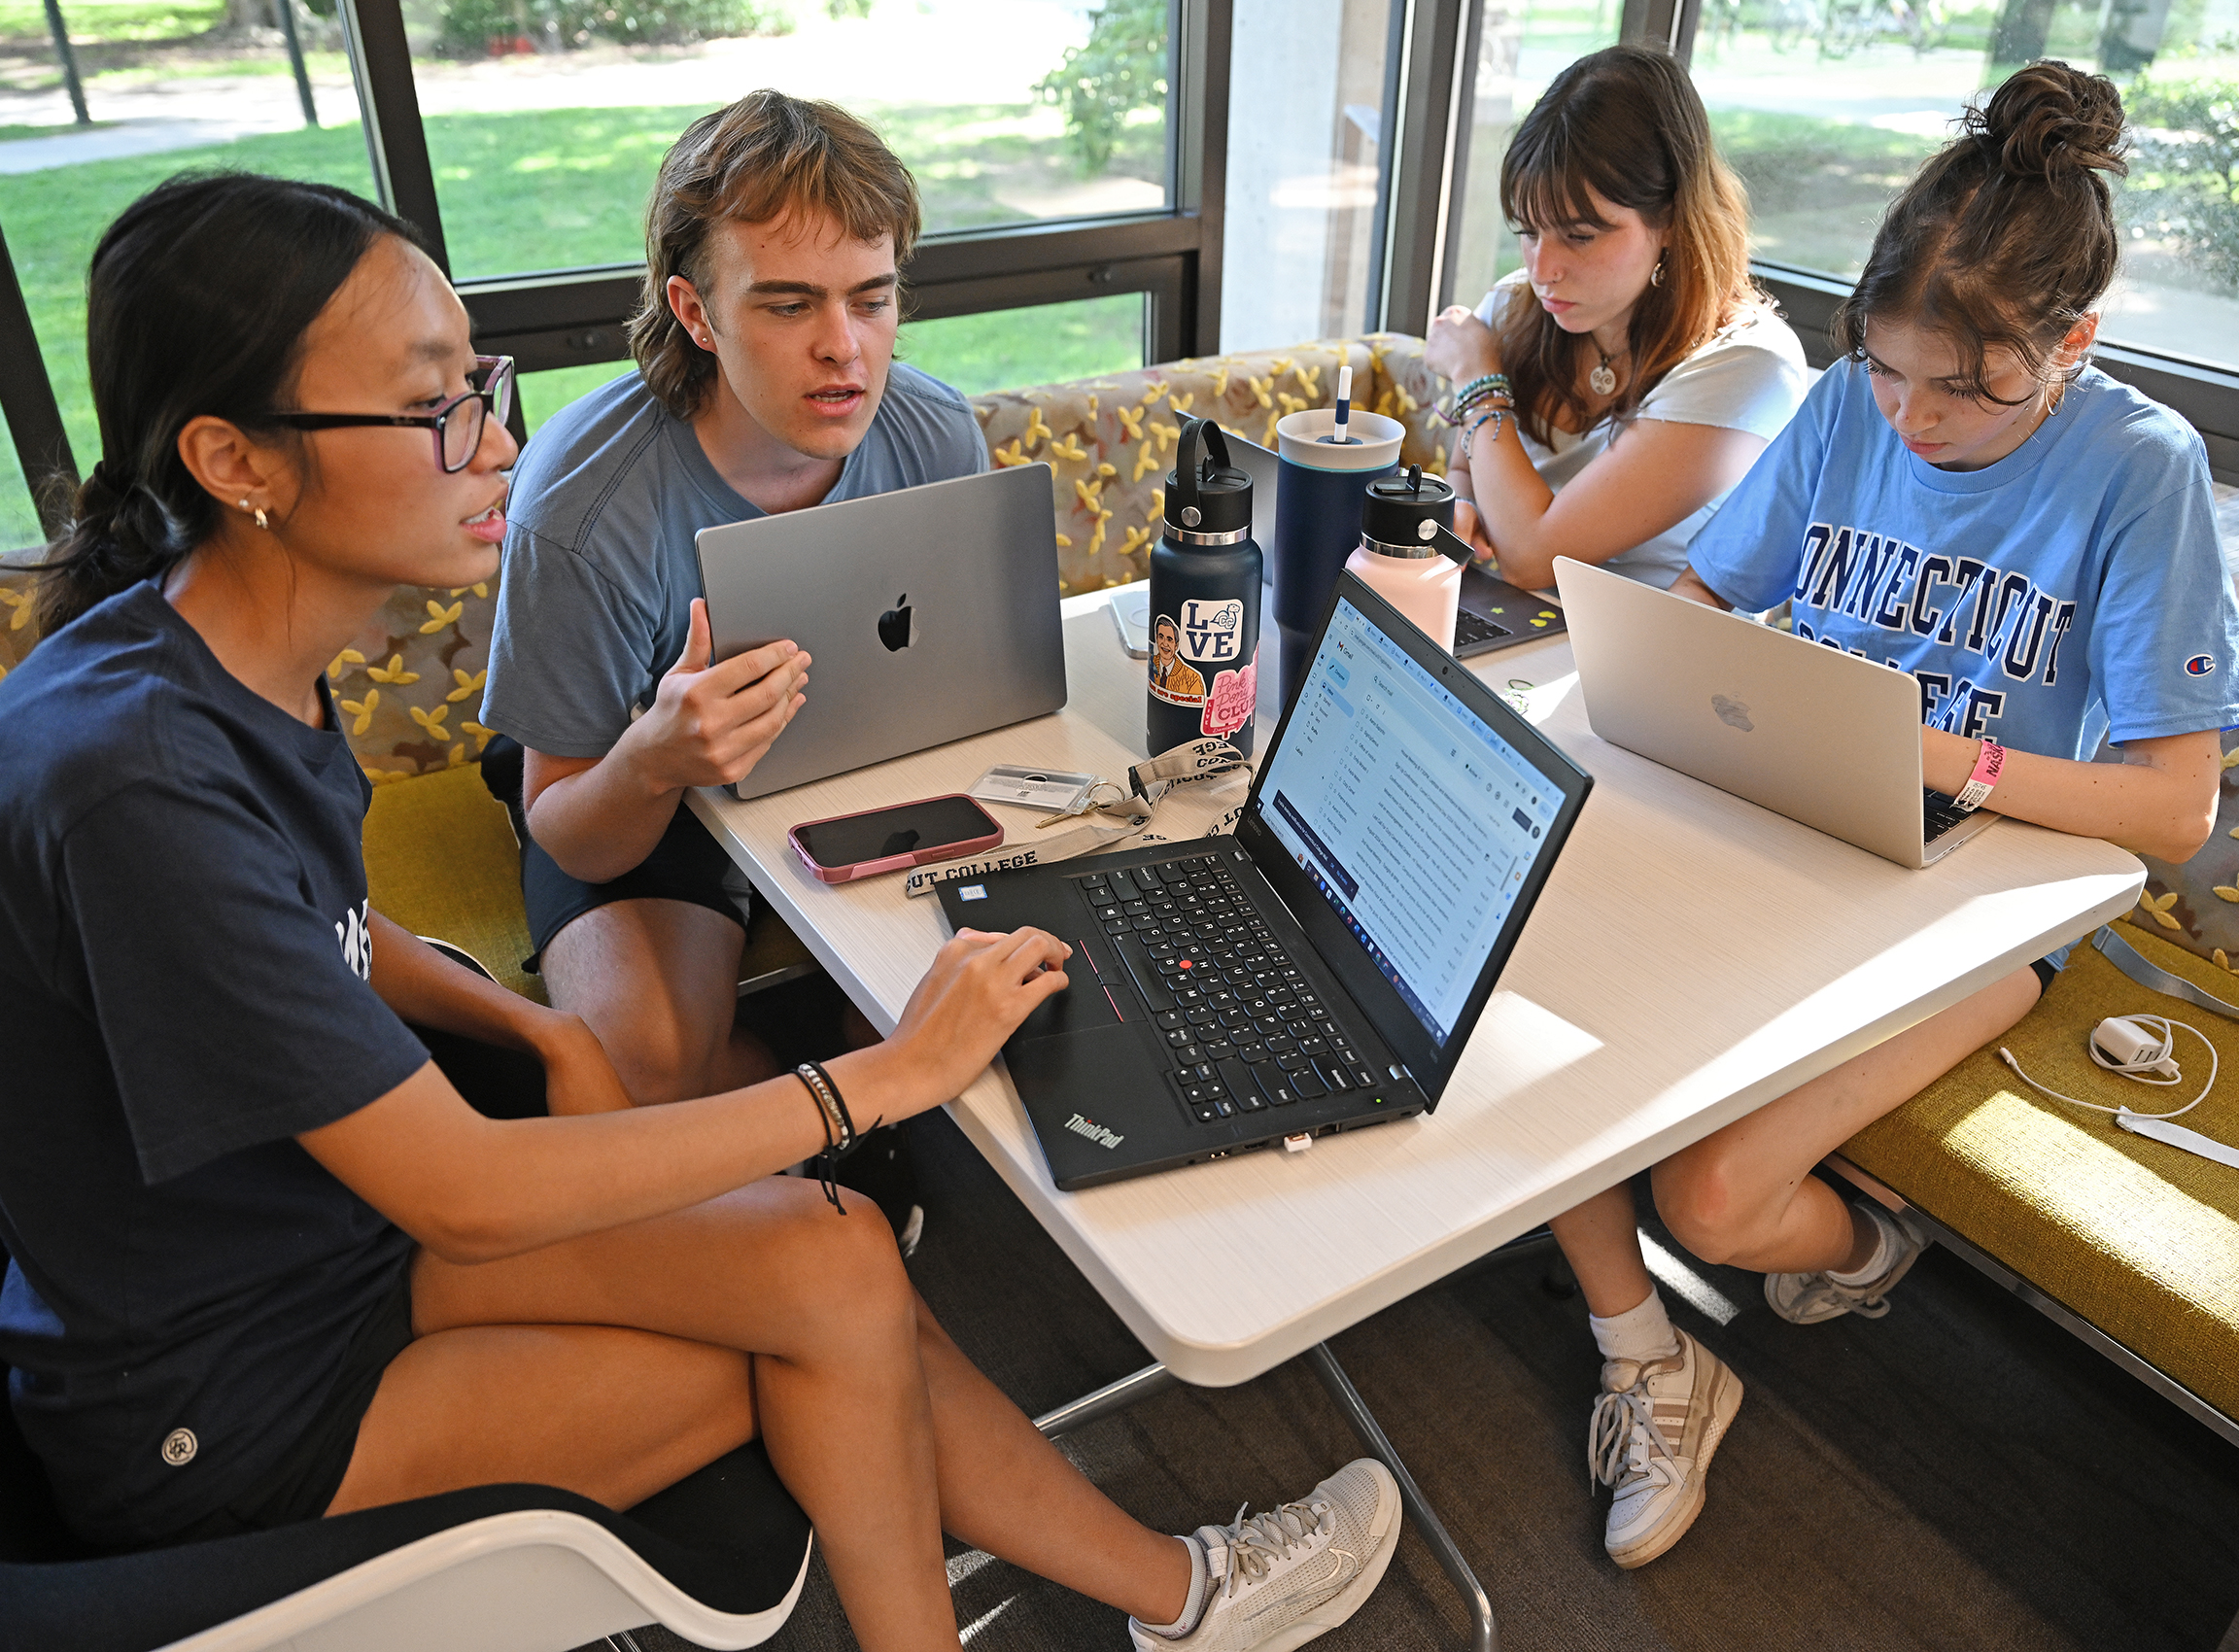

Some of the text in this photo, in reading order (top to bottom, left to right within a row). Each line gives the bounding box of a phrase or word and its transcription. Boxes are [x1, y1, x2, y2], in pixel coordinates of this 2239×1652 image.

[1794, 522, 2078, 686] ONNECTICUT
[1157, 688, 1168, 698] are
[1170, 694, 1202, 704] special
[1218, 671, 1247, 694] Pink
[1216, 688, 1252, 712] Pony
[1217, 694, 1257, 721] CLUB
[945, 850, 1039, 880] COLLEGE
[1064, 1113, 1124, 1149] ThinkPad
